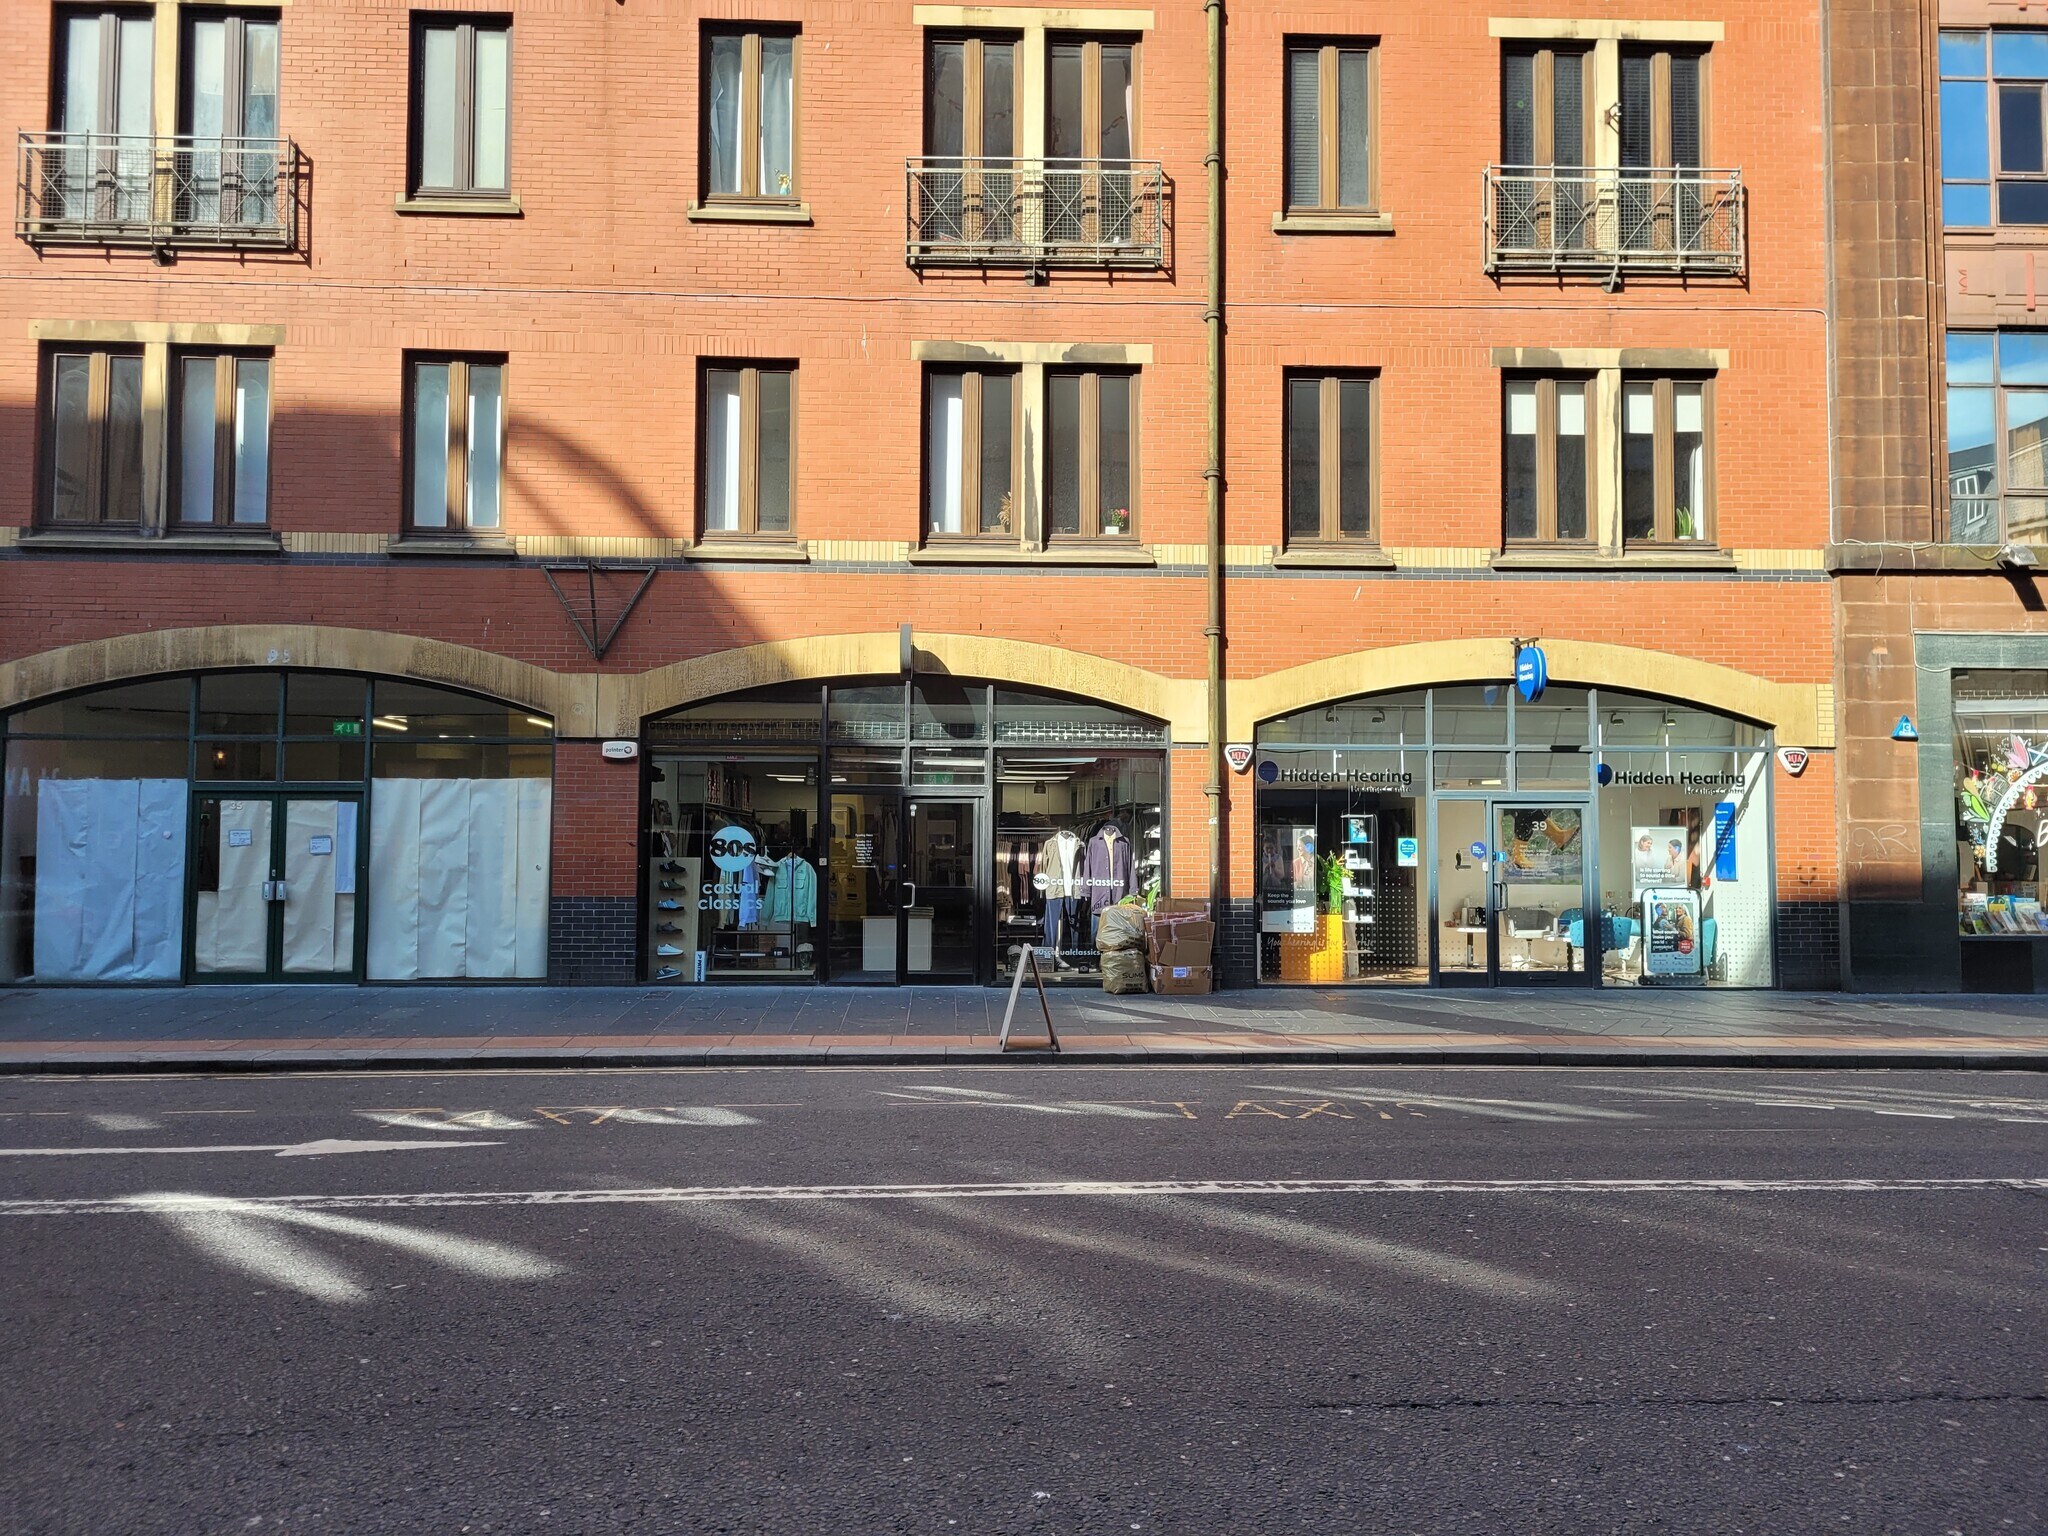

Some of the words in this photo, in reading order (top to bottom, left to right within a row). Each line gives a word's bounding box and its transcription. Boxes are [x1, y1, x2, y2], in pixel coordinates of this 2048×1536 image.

[1281, 769, 1341, 783] Hidden
[1347, 769, 1412, 785] Hearing
[1615, 771, 1675, 785] Hidden
[1680, 771, 1746, 787] Hearing
[1531, 821, 1548, 831] 39
[710, 838, 757, 857] 80s
[702, 880, 759, 894] casual
[1050, 877, 1084, 886] caual
[697, 896, 764, 910] classcs
